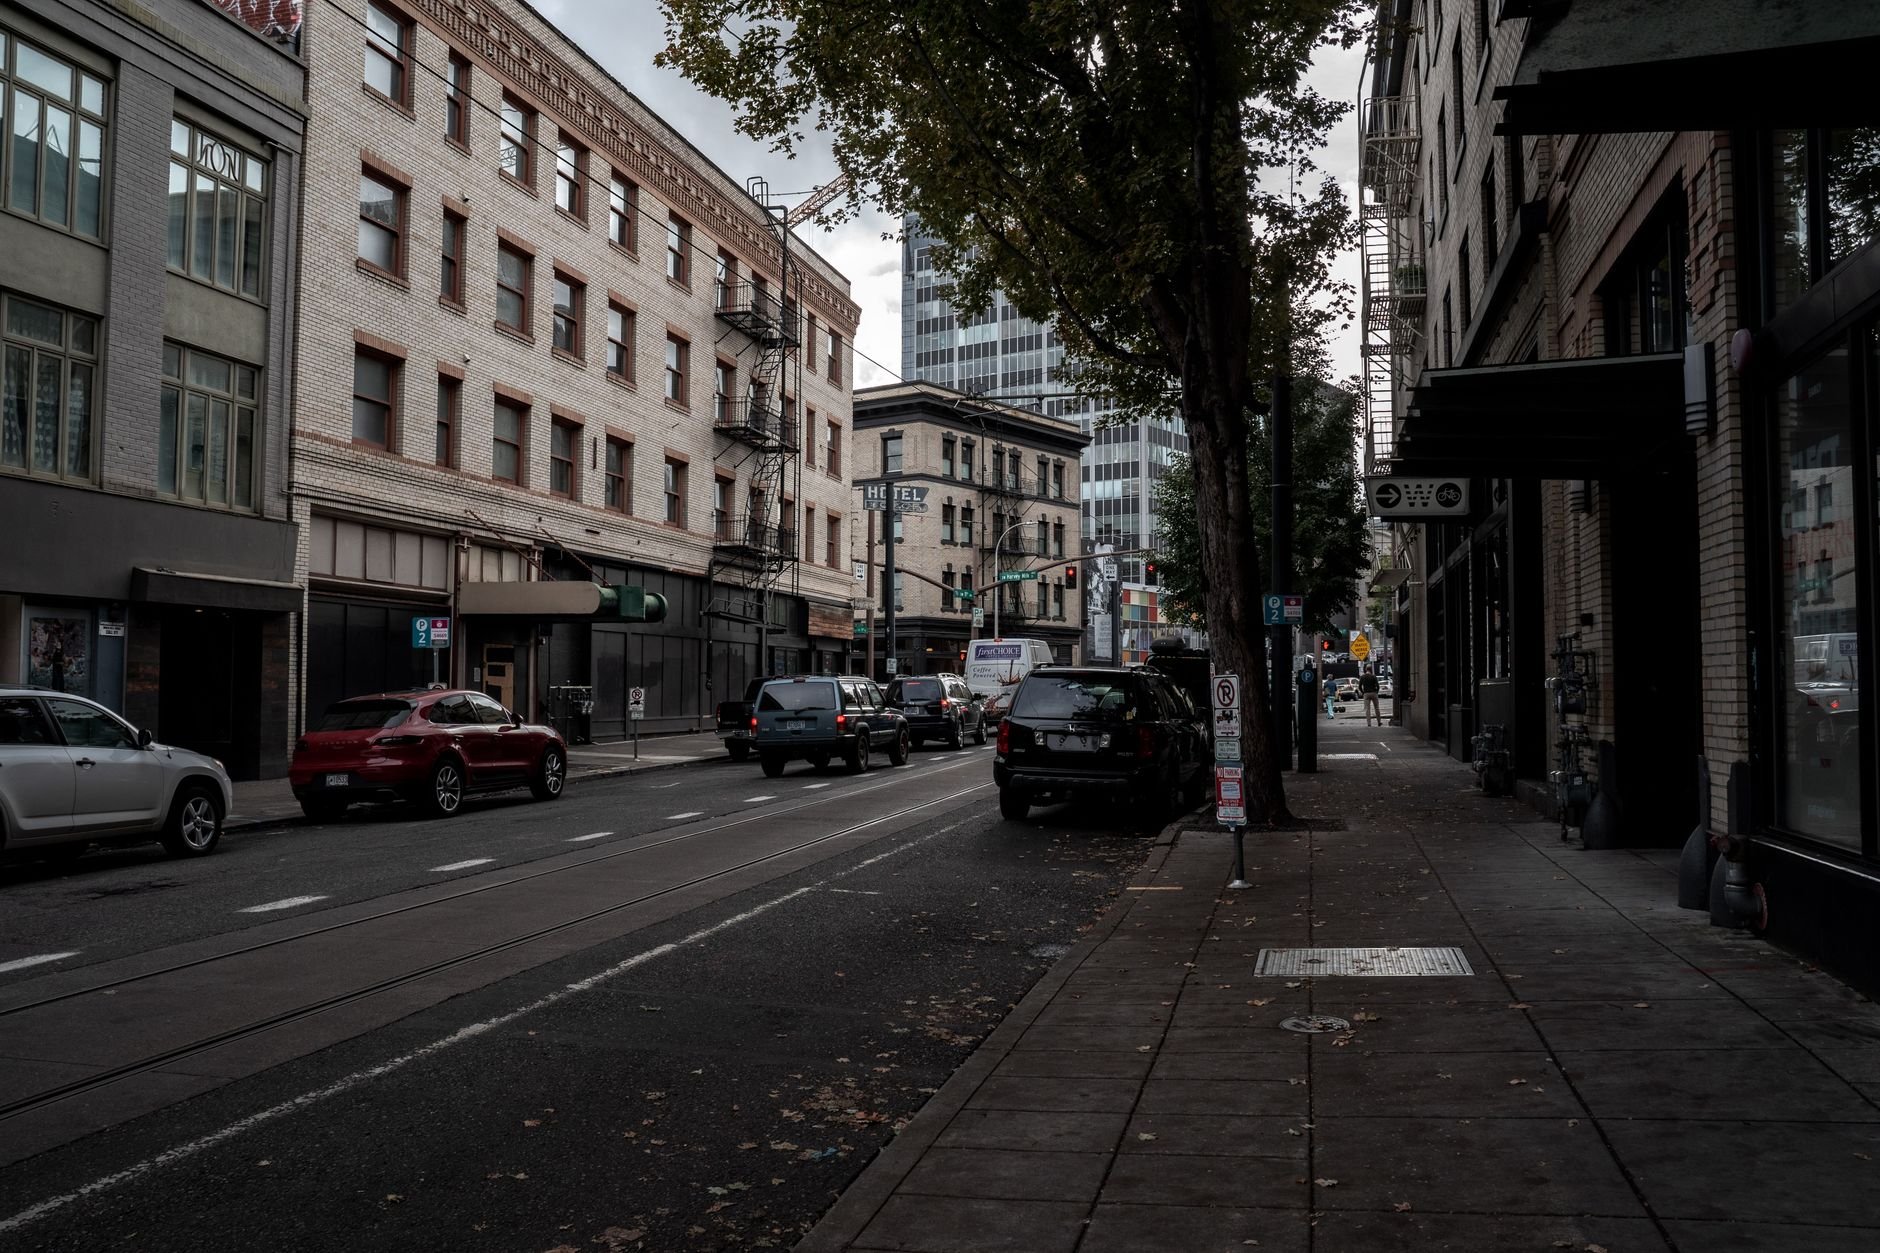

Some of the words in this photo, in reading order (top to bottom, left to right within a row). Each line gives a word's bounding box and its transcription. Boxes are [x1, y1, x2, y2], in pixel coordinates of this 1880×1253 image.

[868, 486, 921, 500] HOTEL
[1271, 610, 1279, 620] 2
[418, 632, 426, 643] 2
[1216, 768, 1223, 777] NO
